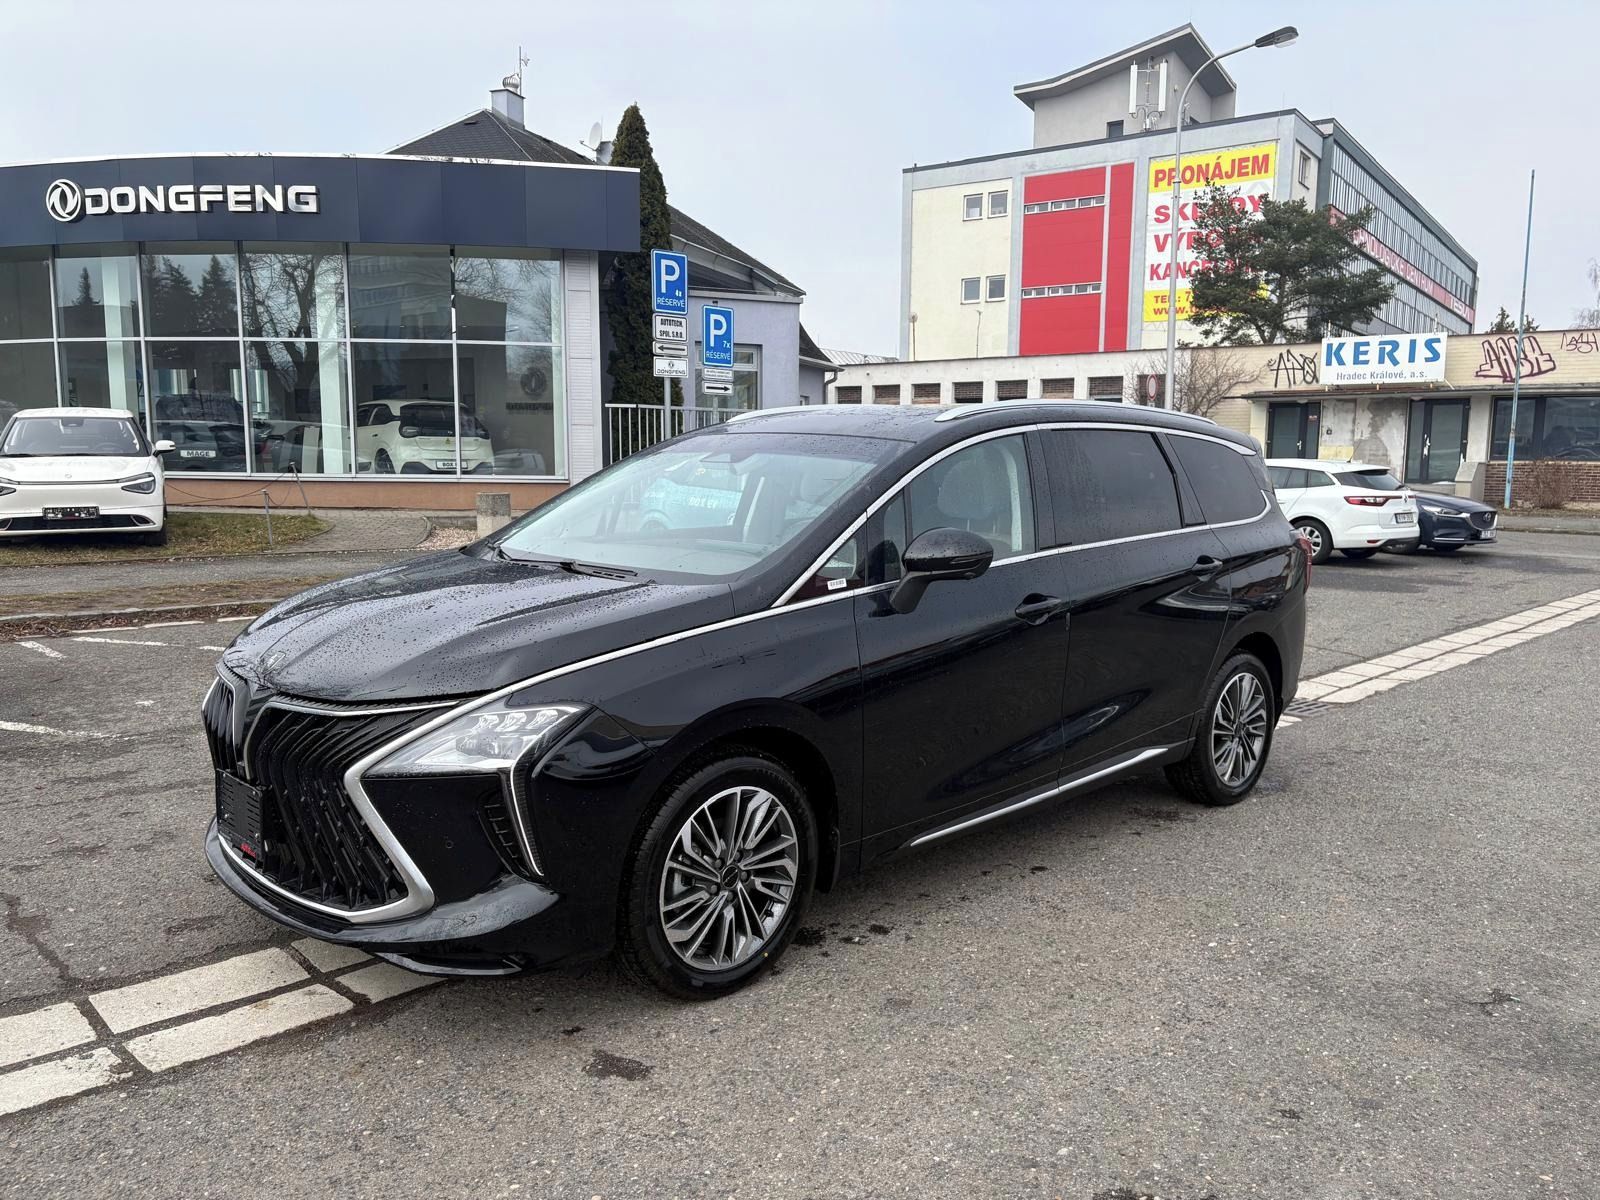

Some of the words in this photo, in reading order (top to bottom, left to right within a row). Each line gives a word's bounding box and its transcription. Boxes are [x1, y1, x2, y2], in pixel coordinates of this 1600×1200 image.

[84, 184, 318, 215] DONGFENG
[661, 258, 680, 294] P
[1448, 293, 1471, 321] TESLA
[709, 313, 727, 348] P
[722, 340, 731, 349] 7x
[1325, 337, 1442, 367] KERIS
[1336, 372, 1367, 381] Hradec
[1370, 369, 1407, 381] Králové,
[1410, 370, 1428, 379] a.s.
[186, 450, 210, 458] MAGE
